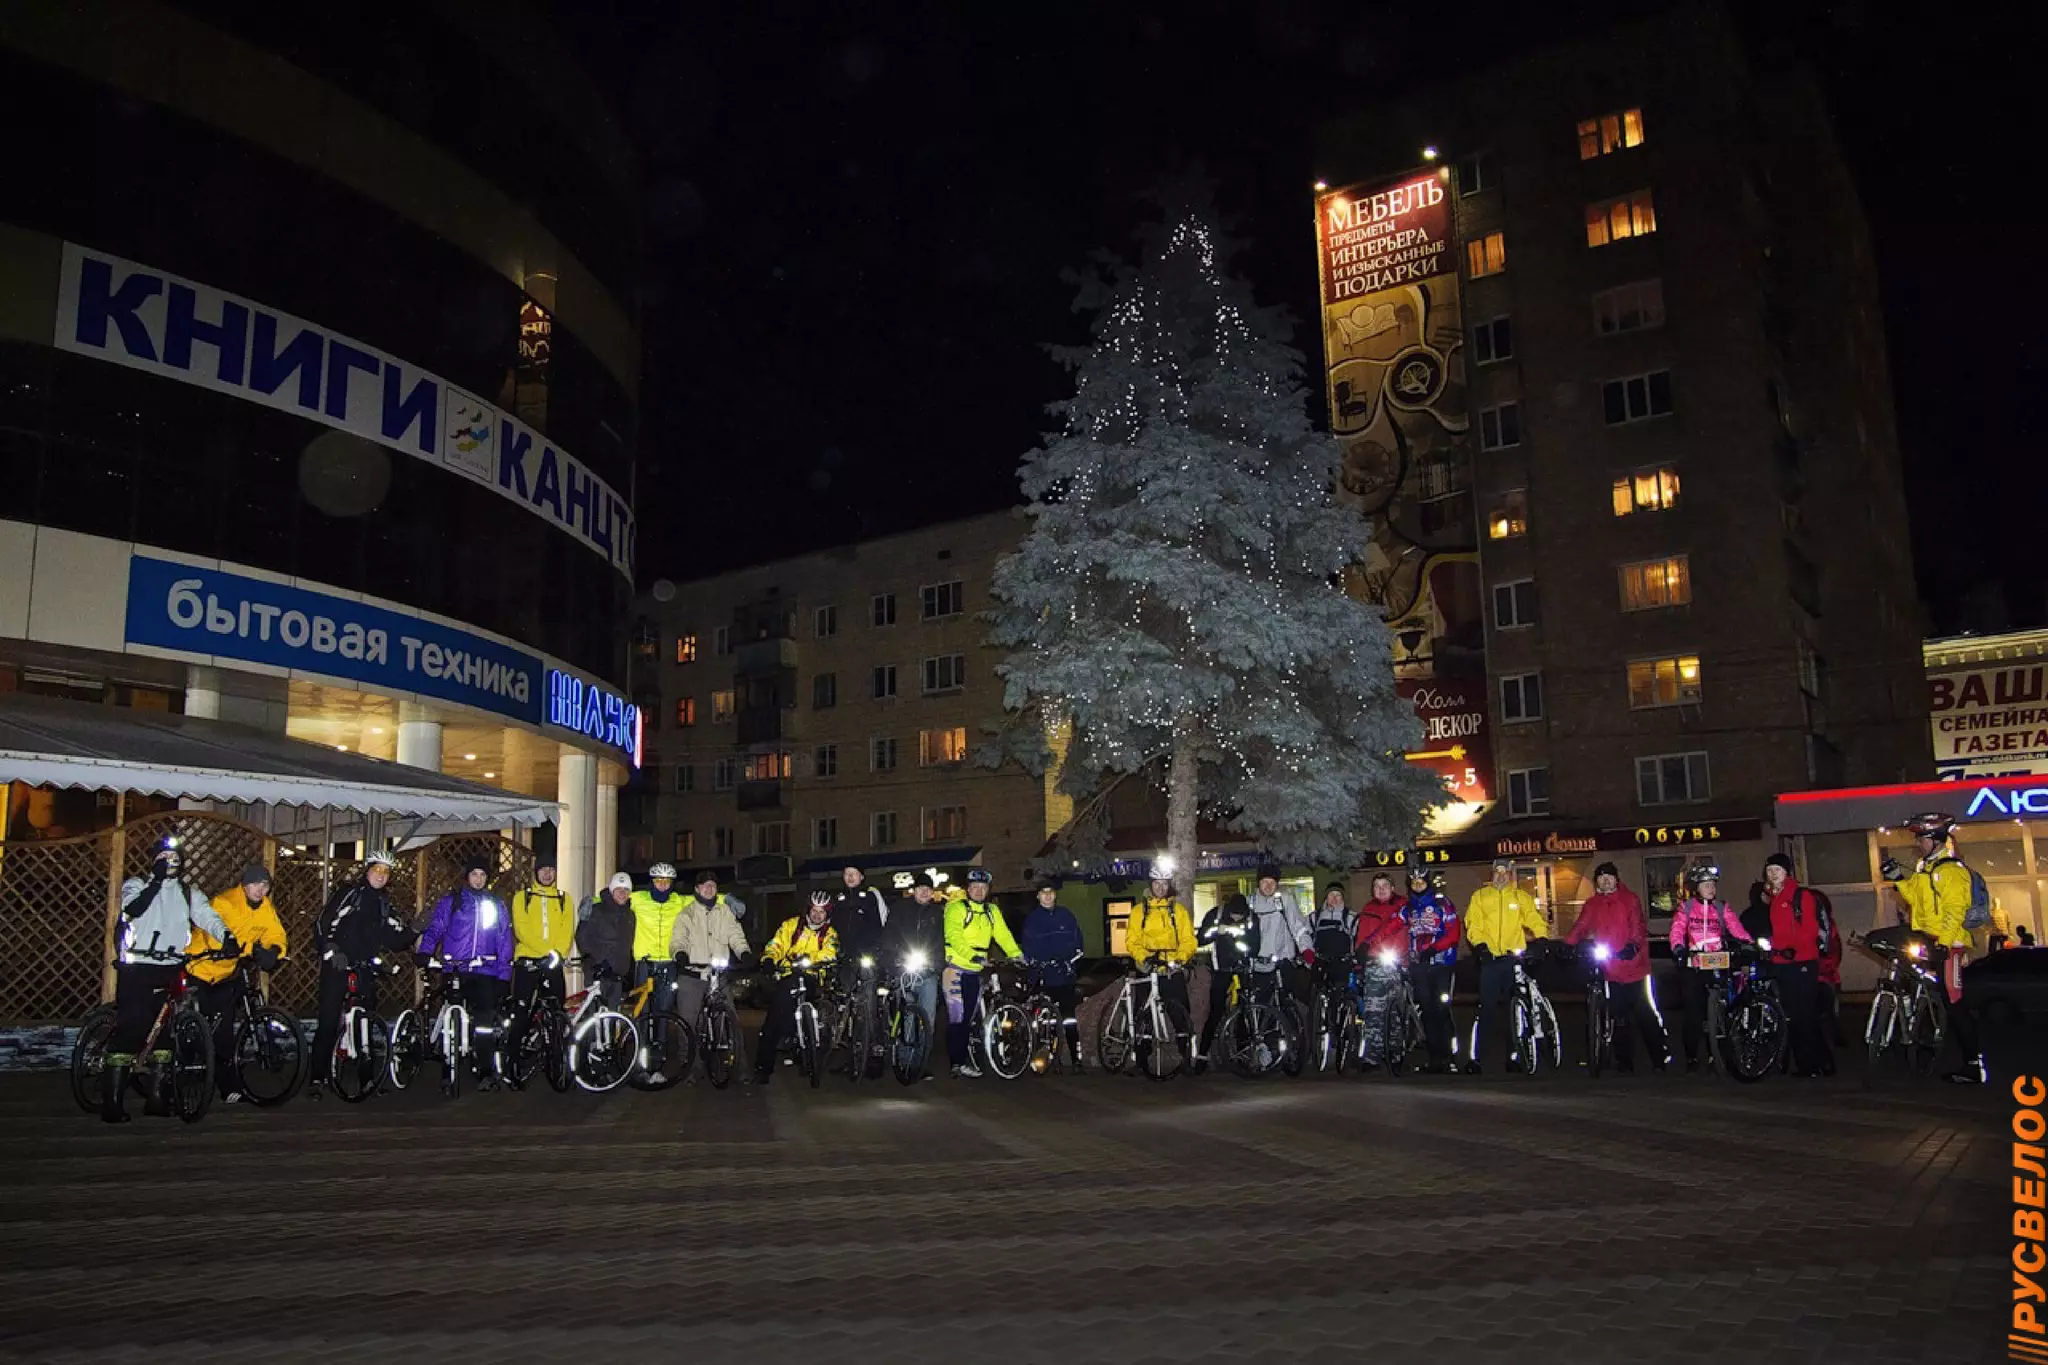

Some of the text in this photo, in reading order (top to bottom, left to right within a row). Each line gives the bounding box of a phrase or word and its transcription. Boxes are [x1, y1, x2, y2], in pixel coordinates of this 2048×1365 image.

[1327, 178, 1444, 235] МЕБЕЛЬ
[1329, 219, 1396, 249] ПРЕДМЕТЫ
[1331, 227, 1429, 267] ИНТЕРЬЕРА
[1332, 240, 1446, 281] И ИЗЫСКАННЫЕ
[1333, 256, 1440, 299] ПОДАРКИ
[76, 257, 438, 456] КНИГИ
[167, 579, 530, 704] бытовая техника
[1927, 666, 2048, 711] ВАШ
[551, 669, 636, 754] ШАНС
[1954, 729, 2048, 754] ГАЗЕТА
[1465, 767, 1477, 787] 5
[1634, 826, 1721, 845] Обувь
[1375, 849, 1450, 866] Обвь
